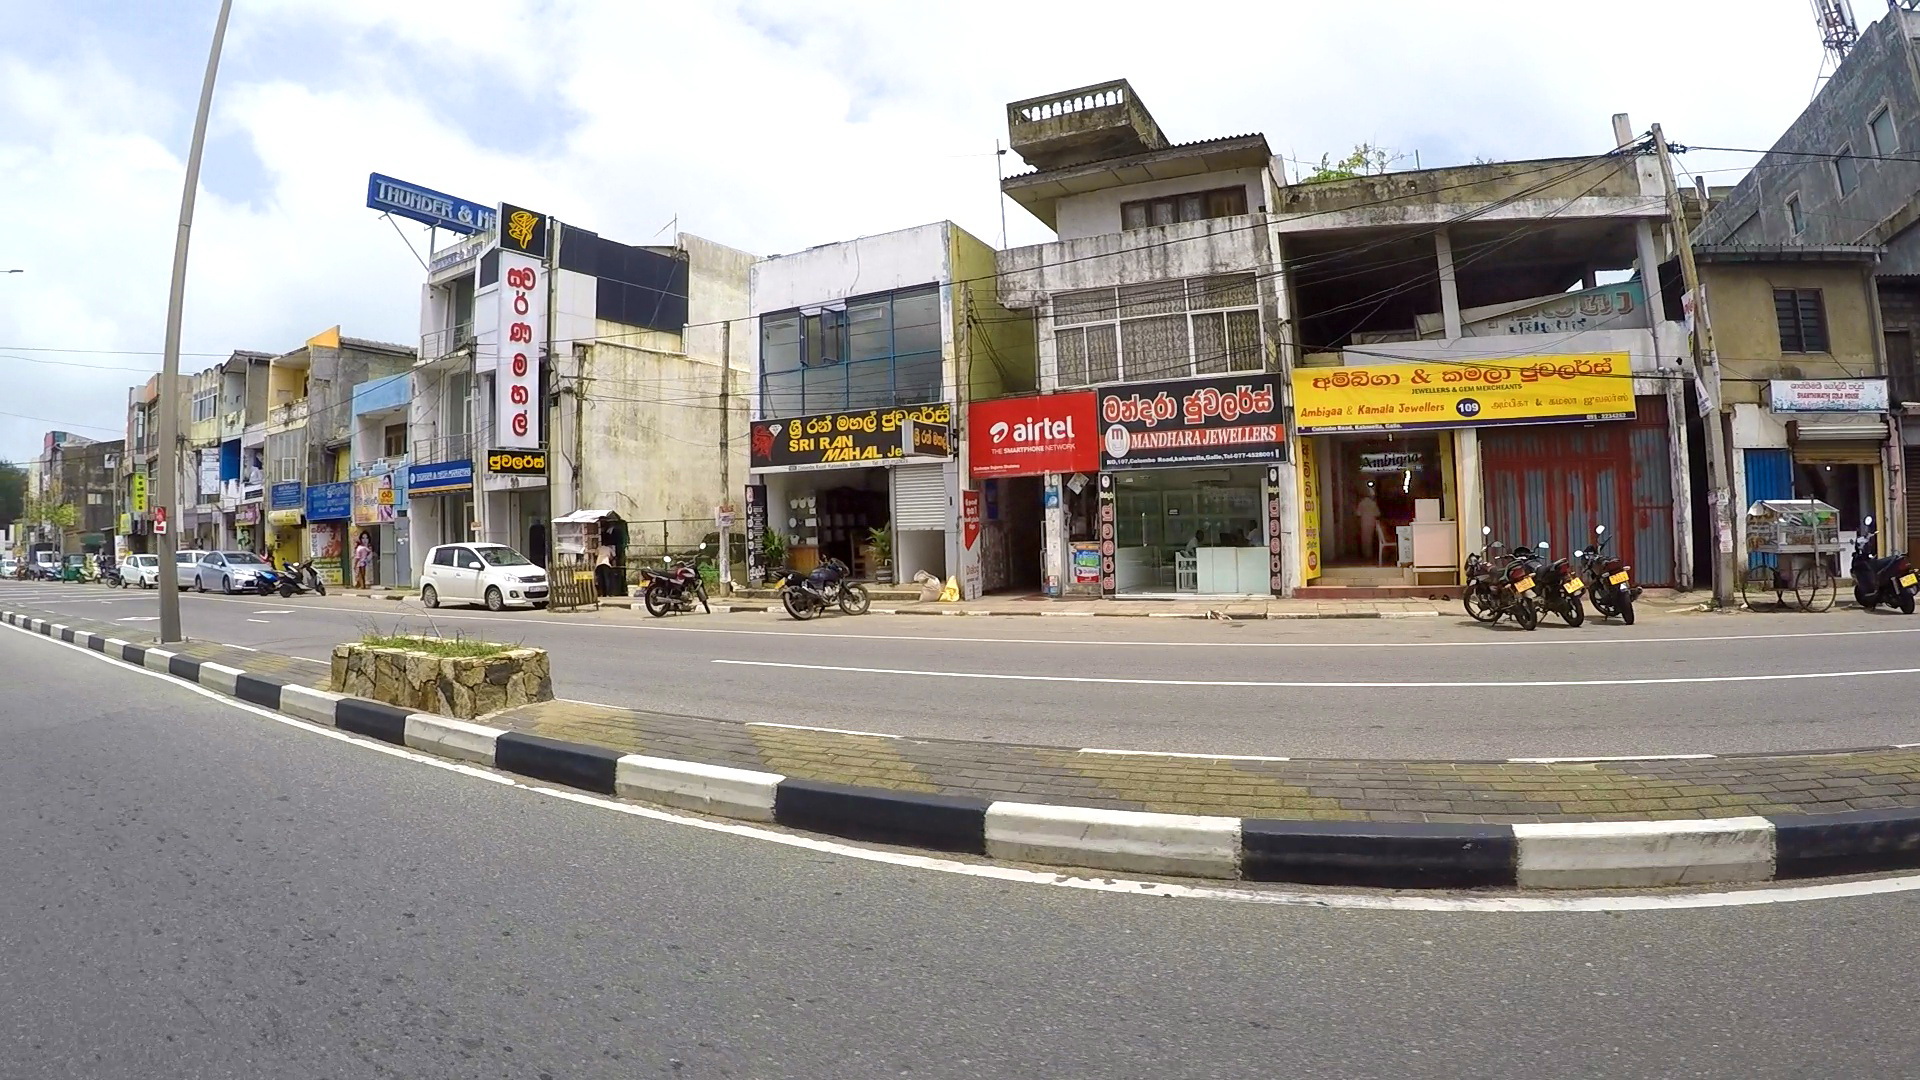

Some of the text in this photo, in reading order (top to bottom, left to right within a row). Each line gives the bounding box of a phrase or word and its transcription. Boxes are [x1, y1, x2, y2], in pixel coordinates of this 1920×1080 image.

[376, 179, 454, 219] THUNDER
[458, 204, 474, 225] &
[1411, 369, 1432, 385] &
[1411, 387, 1450, 395] JEWELLERS
[1458, 385, 1475, 393] GEM
[1300, 402, 1445, 418] Ambigaa & Kamala Jewellers
[1457, 402, 1479, 413] 109
[1013, 415, 1075, 442] airtel
[789, 435, 853, 452] SRI RAN
[1131, 426, 1277, 449] MANDHARA JEWELLERS
[822, 445, 883, 463] MAHAL
[1003, 445, 1044, 454] SMARTPHONE
[1044, 443, 1076, 451] NETWORK
